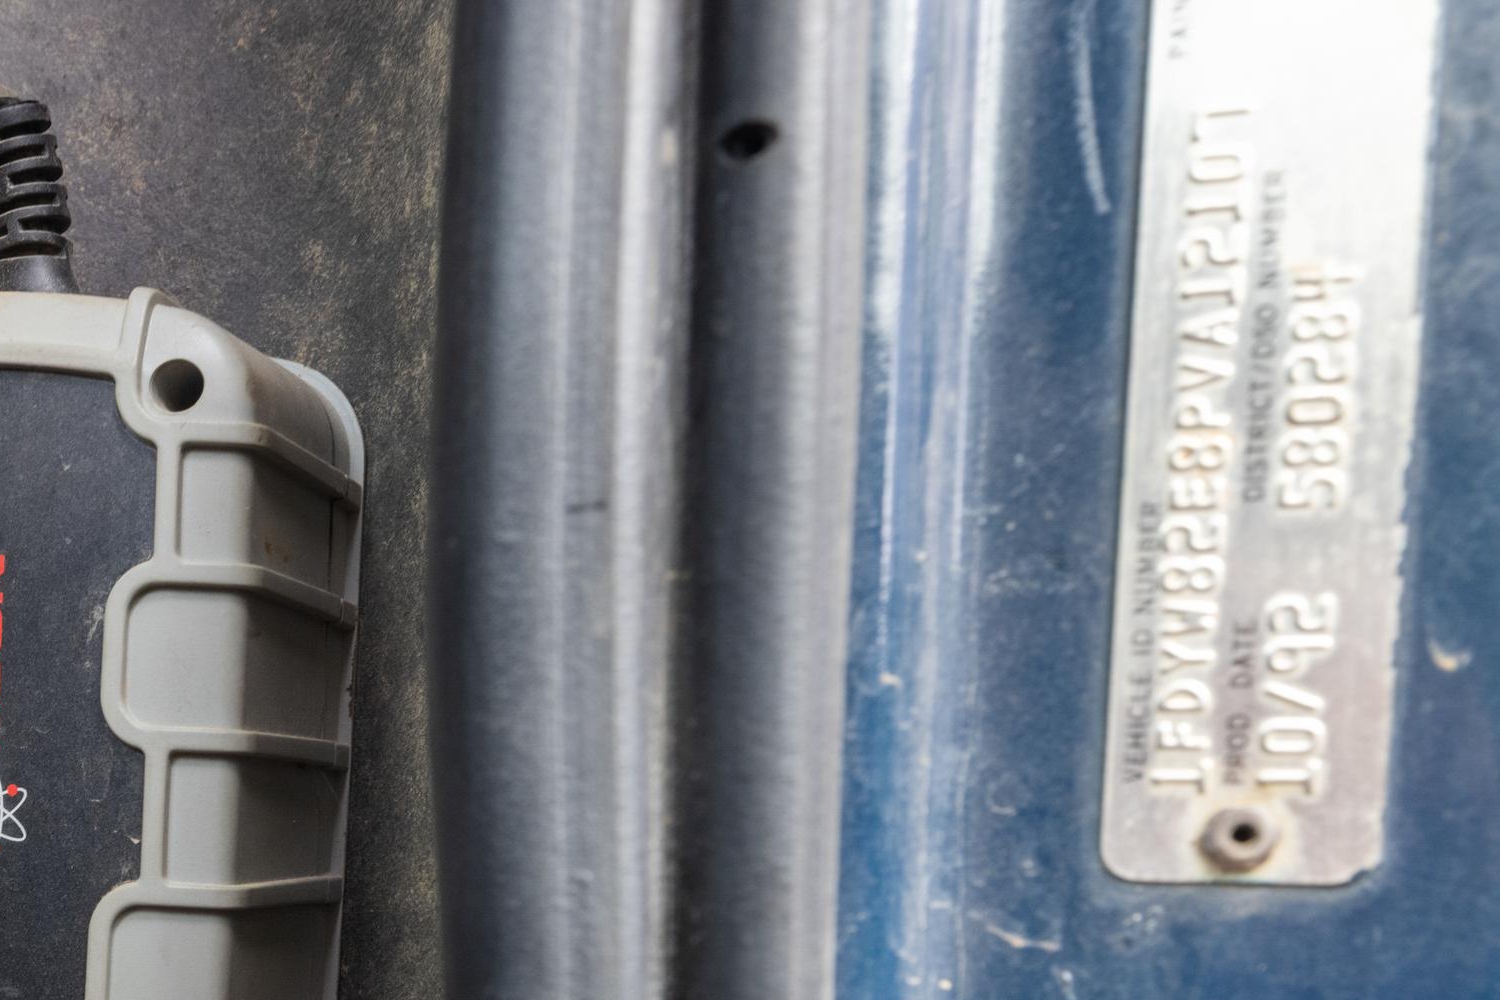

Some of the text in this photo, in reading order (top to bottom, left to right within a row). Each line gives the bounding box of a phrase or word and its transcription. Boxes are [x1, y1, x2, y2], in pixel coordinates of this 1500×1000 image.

[1122, 500, 1160, 783] VEHICLE ID NUMBER
[1230, 618, 1256, 689] DATE
[1256, 591, 1339, 797] 10/92
